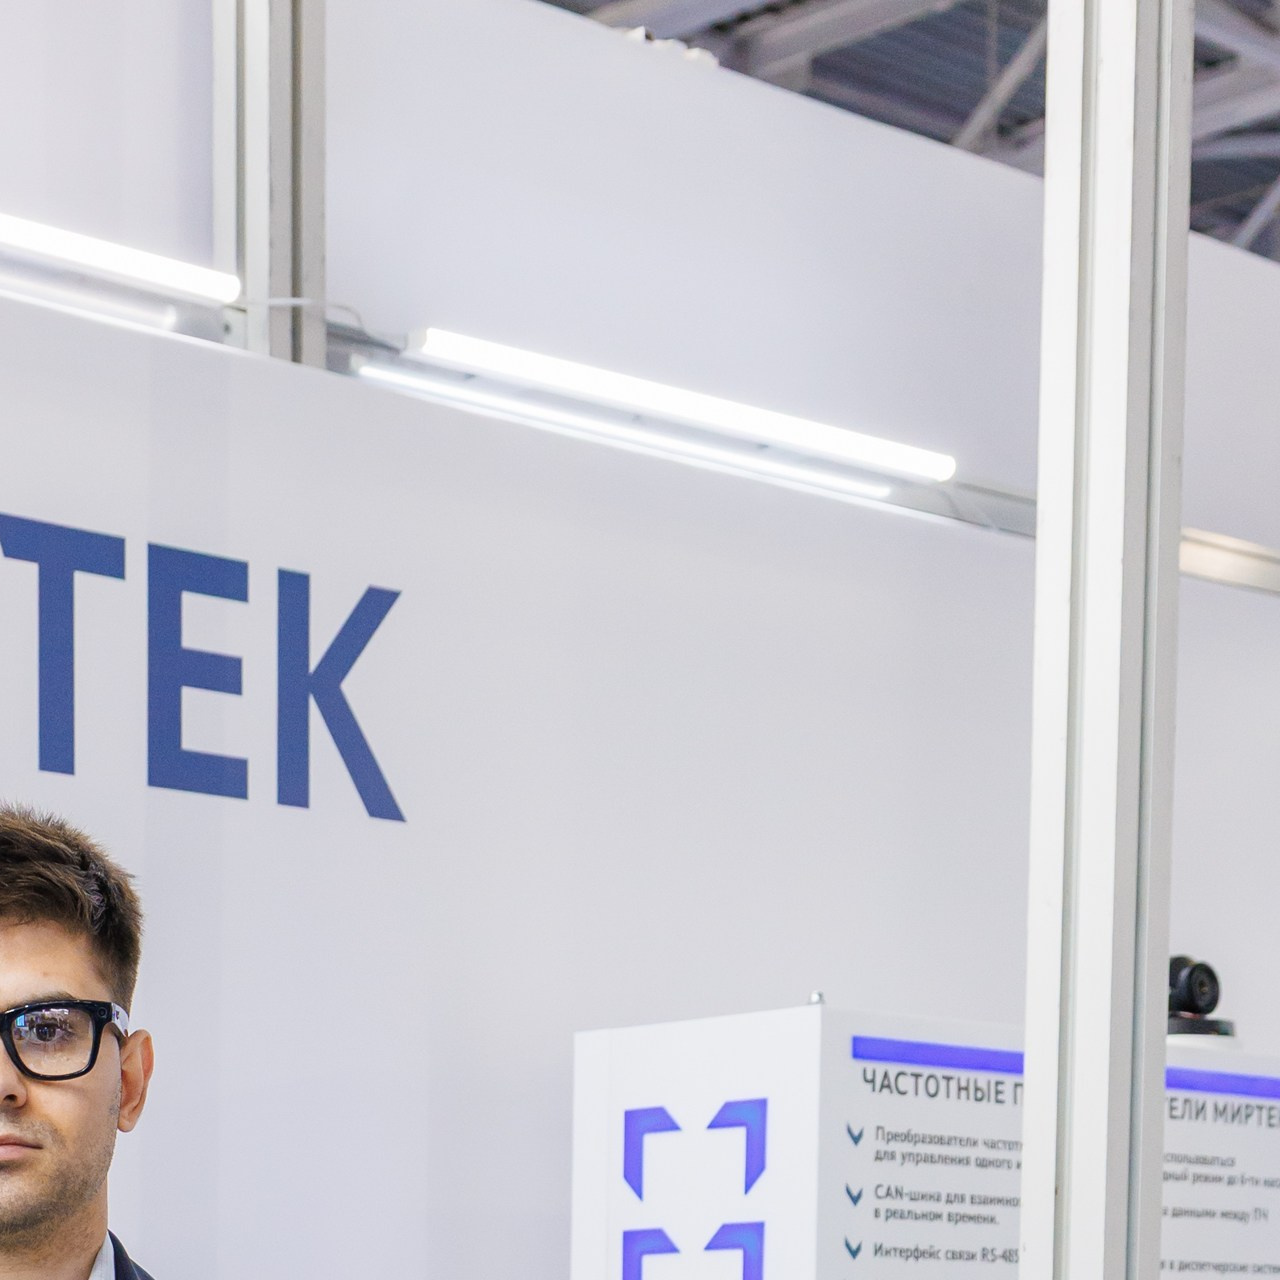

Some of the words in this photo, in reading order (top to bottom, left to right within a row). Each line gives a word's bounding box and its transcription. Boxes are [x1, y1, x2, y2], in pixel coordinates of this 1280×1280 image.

[863, 1067, 1006, 1104] ЧАСТОТНЫЕ
[1166, 1097, 1207, 1121] ЕЛИ
[1213, 1100, 1280, 1128] МИРТЕ
[875, 1125, 979, 1147] Преобразователи
[983, 1138, 1023, 1151] частот
[874, 1150, 897, 1163] для
[901, 1152, 971, 1167] управления
[975, 1156, 1013, 1170] одного
[874, 1183, 942, 1203] CAN-шина
[945, 1192, 967, 1205] для
[970, 1194, 1022, 1208] взаимно
[873, 1207, 881, 1219] в
[884, 1207, 944, 1222] реальном
[947, 1211, 1000, 1226] времени.
[873, 1242, 942, 1263] Интерфейс
[945, 1249, 978, 1262] связи
